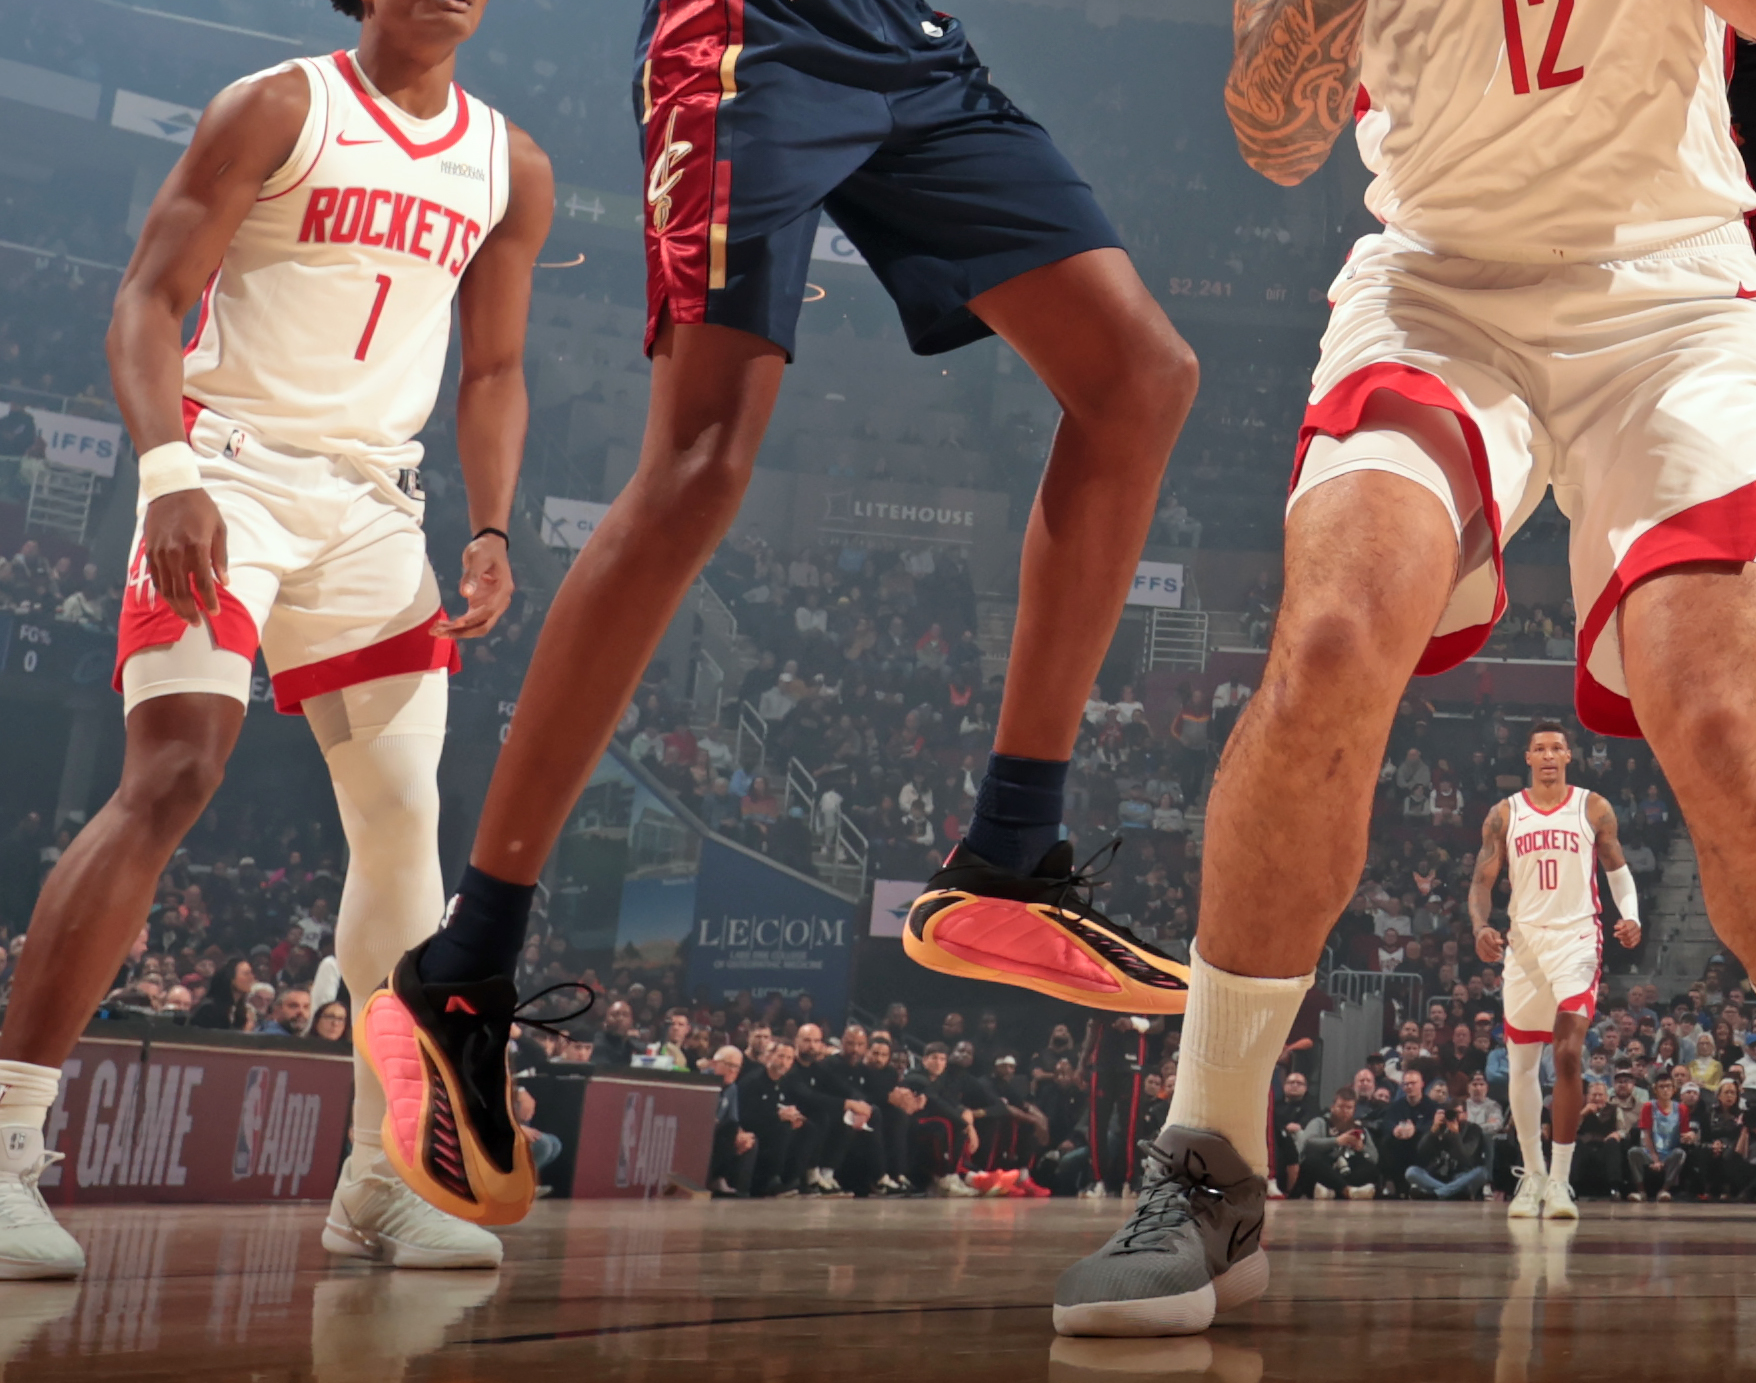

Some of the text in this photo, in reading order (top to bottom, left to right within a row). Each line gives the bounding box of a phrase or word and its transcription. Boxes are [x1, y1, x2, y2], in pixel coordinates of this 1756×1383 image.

[296, 187, 482, 278] ROCKETS
[353, 273, 392, 363] 1
[37, 428, 114, 459] IFFS
[853, 500, 974, 528] LITEHOUSE
[1133, 576, 1177, 593] FFS
[20, 624, 51, 645] FG%
[24, 650, 38, 673] 0
[498, 700, 516, 716] FG
[1514, 828, 1581, 858] ROCKETS
[1536, 858, 1558, 891] 10
[76, 1060, 204, 1188] GAME
[256, 1070, 322, 1197] App
[632, 1094, 678, 1199] App
